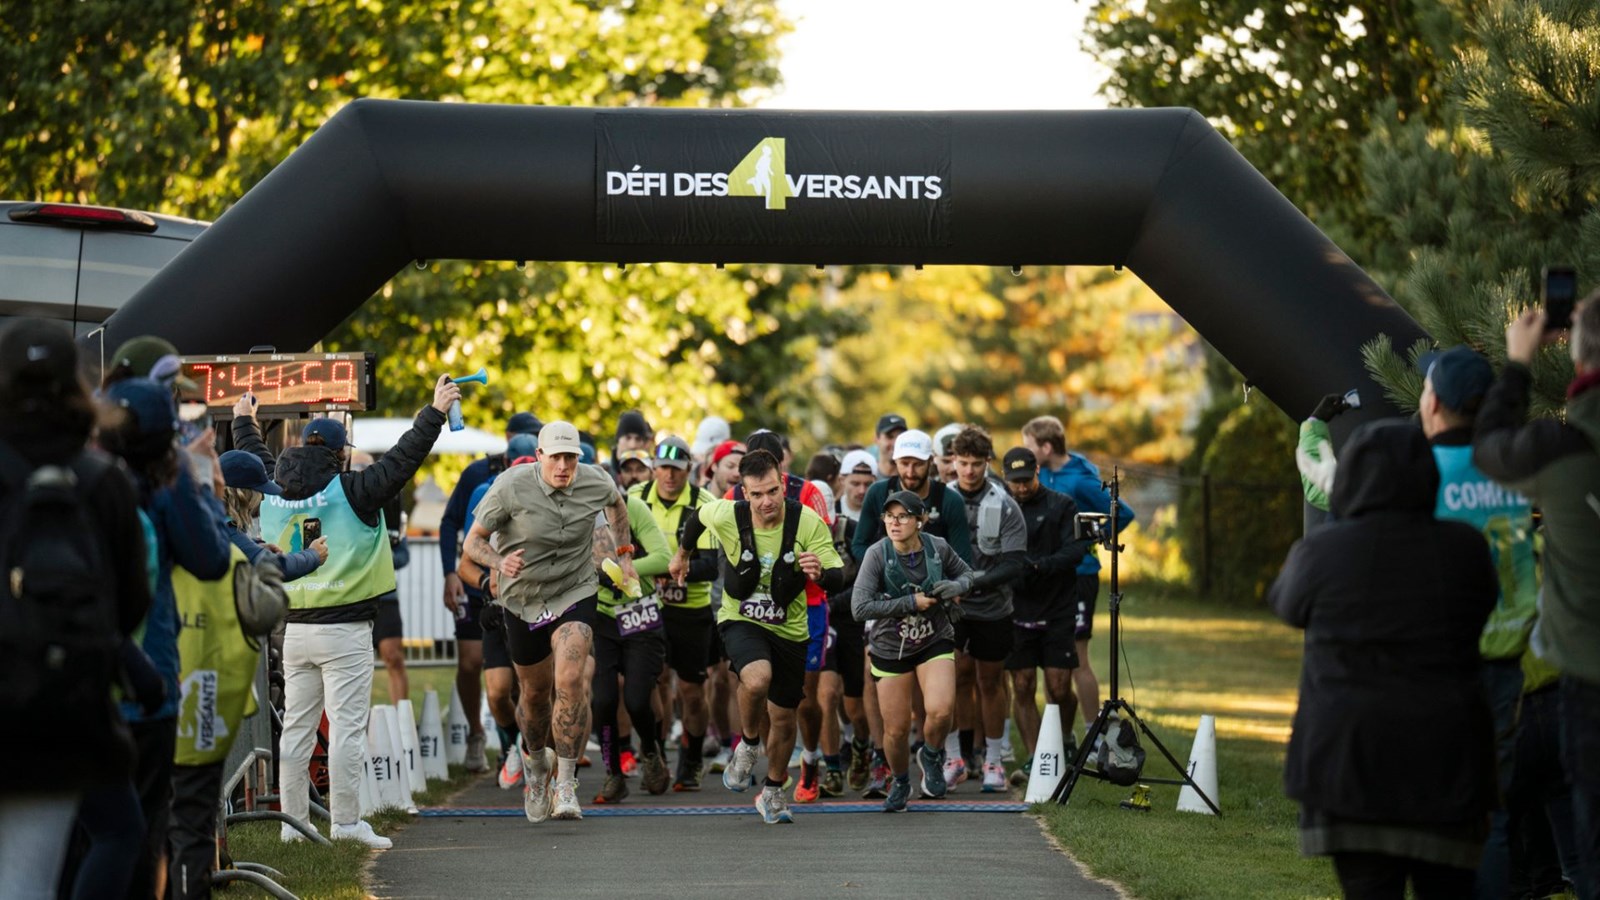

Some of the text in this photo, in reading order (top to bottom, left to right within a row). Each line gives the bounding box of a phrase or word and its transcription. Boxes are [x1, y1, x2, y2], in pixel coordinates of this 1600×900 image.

[606, 137, 942, 210] DÉFI DES 4 VERSANTS
[620, 606, 659, 631] 3045
[743, 603, 785, 621] 3044
[899, 620, 935, 641] 3021
[201, 671, 216, 749] VERSANTS
